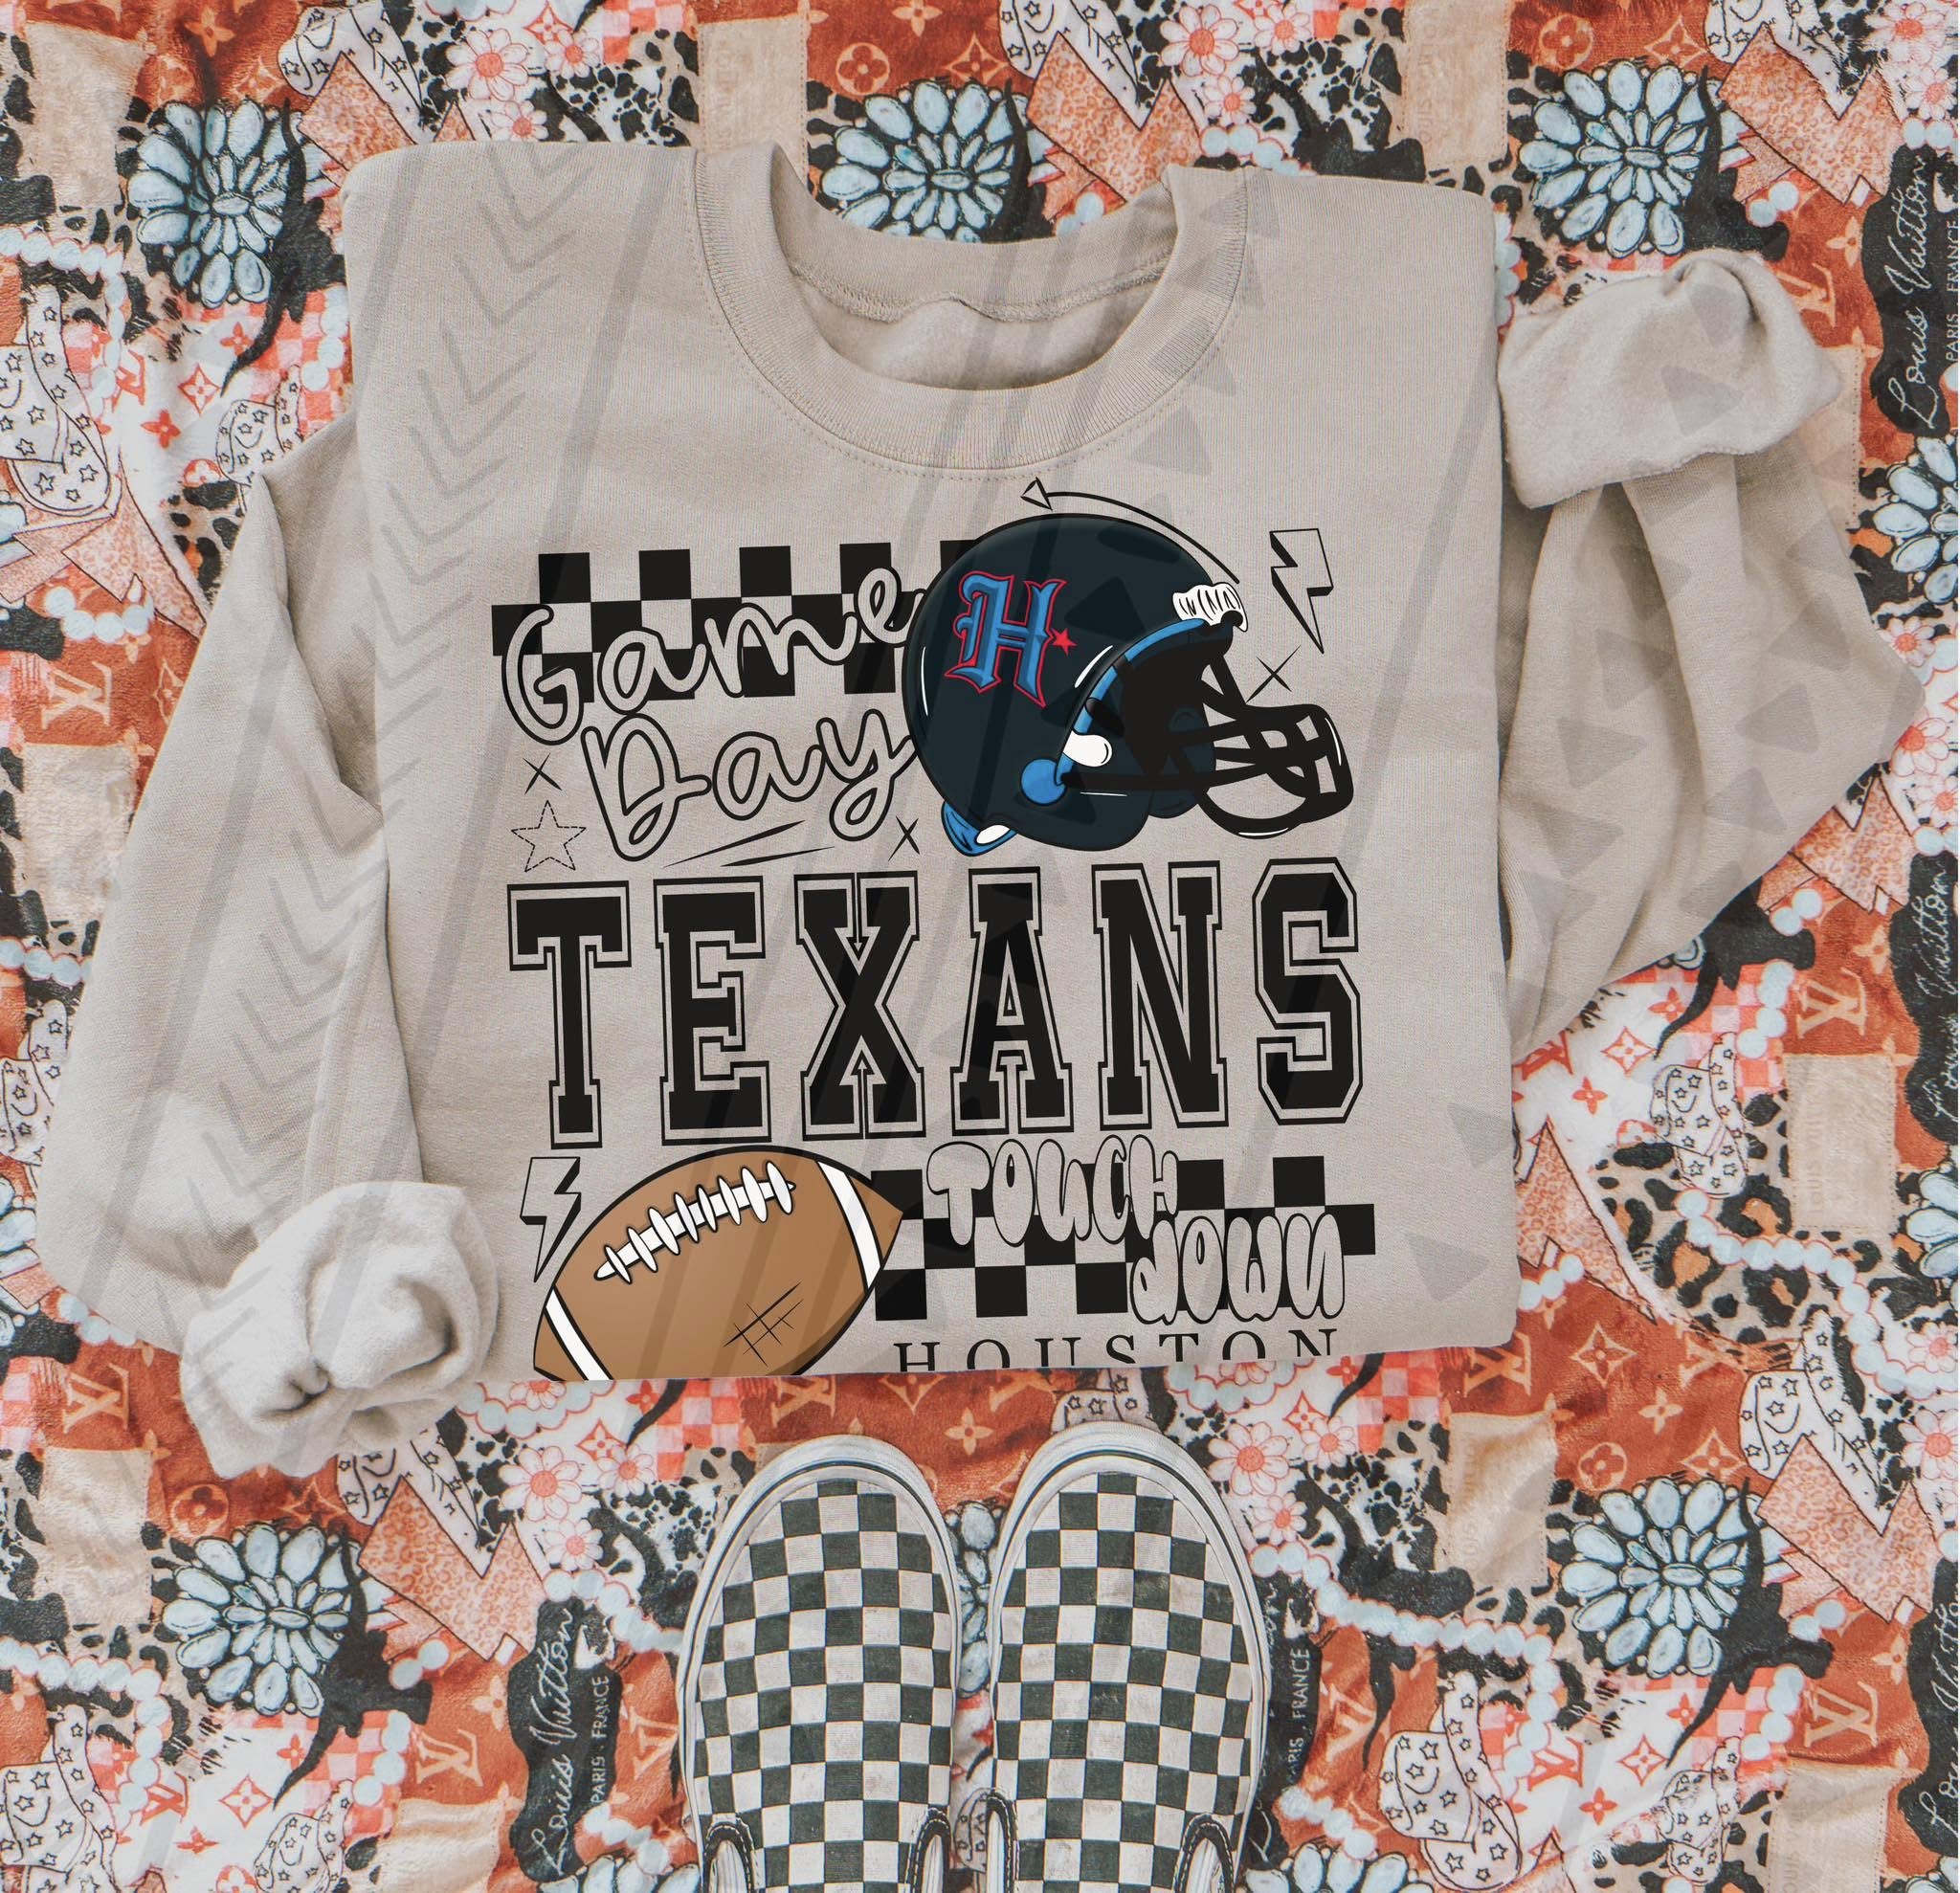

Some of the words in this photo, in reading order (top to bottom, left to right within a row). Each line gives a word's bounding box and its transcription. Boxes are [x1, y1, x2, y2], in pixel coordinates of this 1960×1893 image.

[501, 566, 926, 746] Game
[944, 570, 1068, 709] H
[580, 708, 917, 861] Day
[507, 857, 1364, 1148] TEXANS
[926, 1134, 1179, 1247] TOUCH
[529, 1607, 577, 1746] Vuitton
[591, 1676, 609, 1739] FRANCE
[1290, 1648, 1310, 1719] FRANCE
[530, 1754, 575, 1876] Louis
[590, 1755, 607, 1803] PARIS
